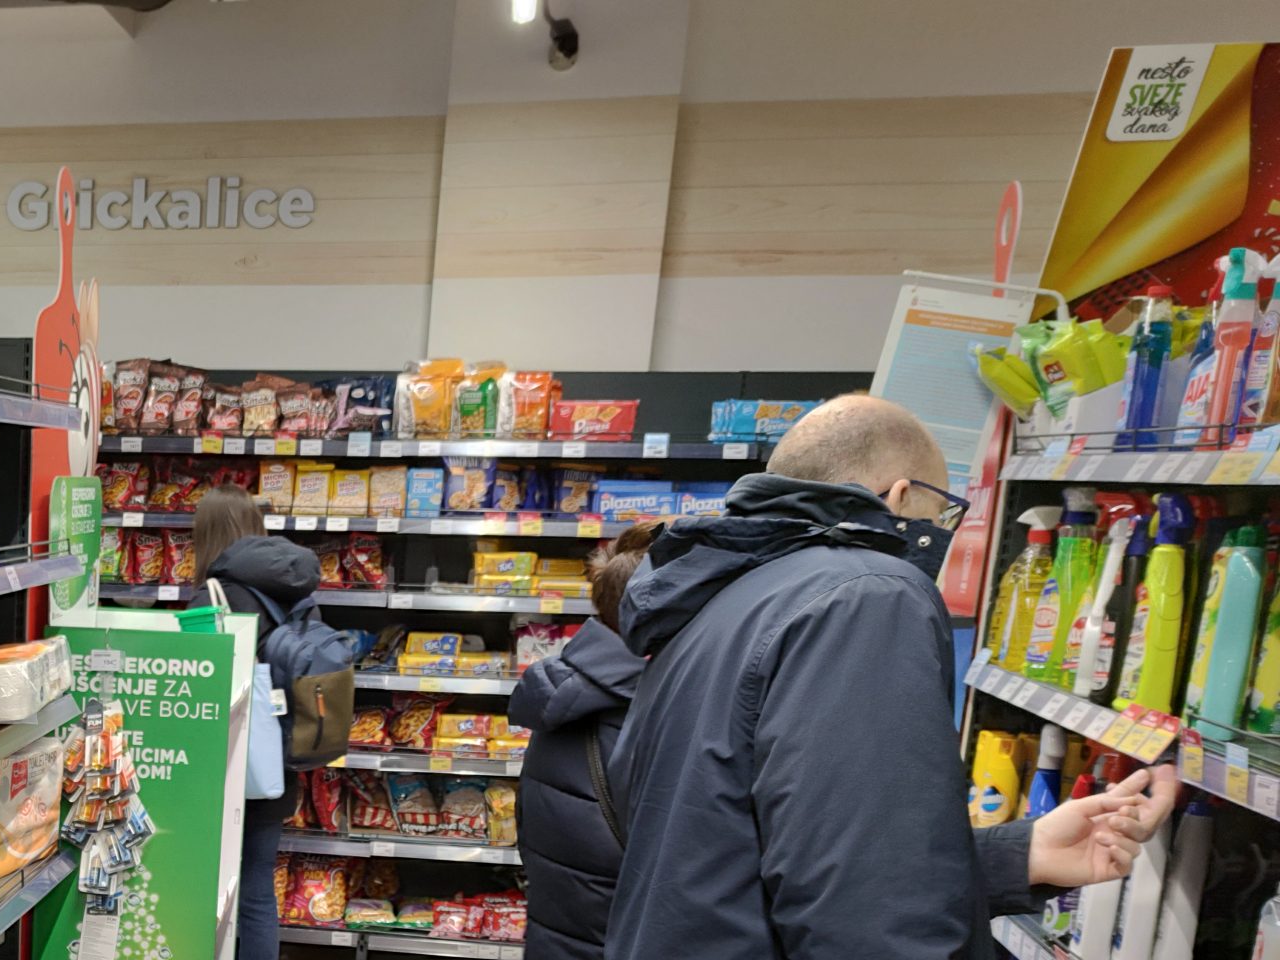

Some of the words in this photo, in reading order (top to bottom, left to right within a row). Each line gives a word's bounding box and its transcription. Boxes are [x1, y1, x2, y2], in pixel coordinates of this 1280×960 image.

[1137, 56, 1195, 80] nešto
[1128, 77, 1187, 107] SVEŽE
[1123, 116, 1170, 134] dana
[6, 176, 316, 232] Gickalice
[263, 473, 290, 482] MICRO
[263, 480, 283, 489] POP
[600, 496, 657, 513] plazma
[71, 655, 215, 678] ESEKORNO
[163, 679, 192, 698] ZA
[159, 700, 219, 720] BOJE!
